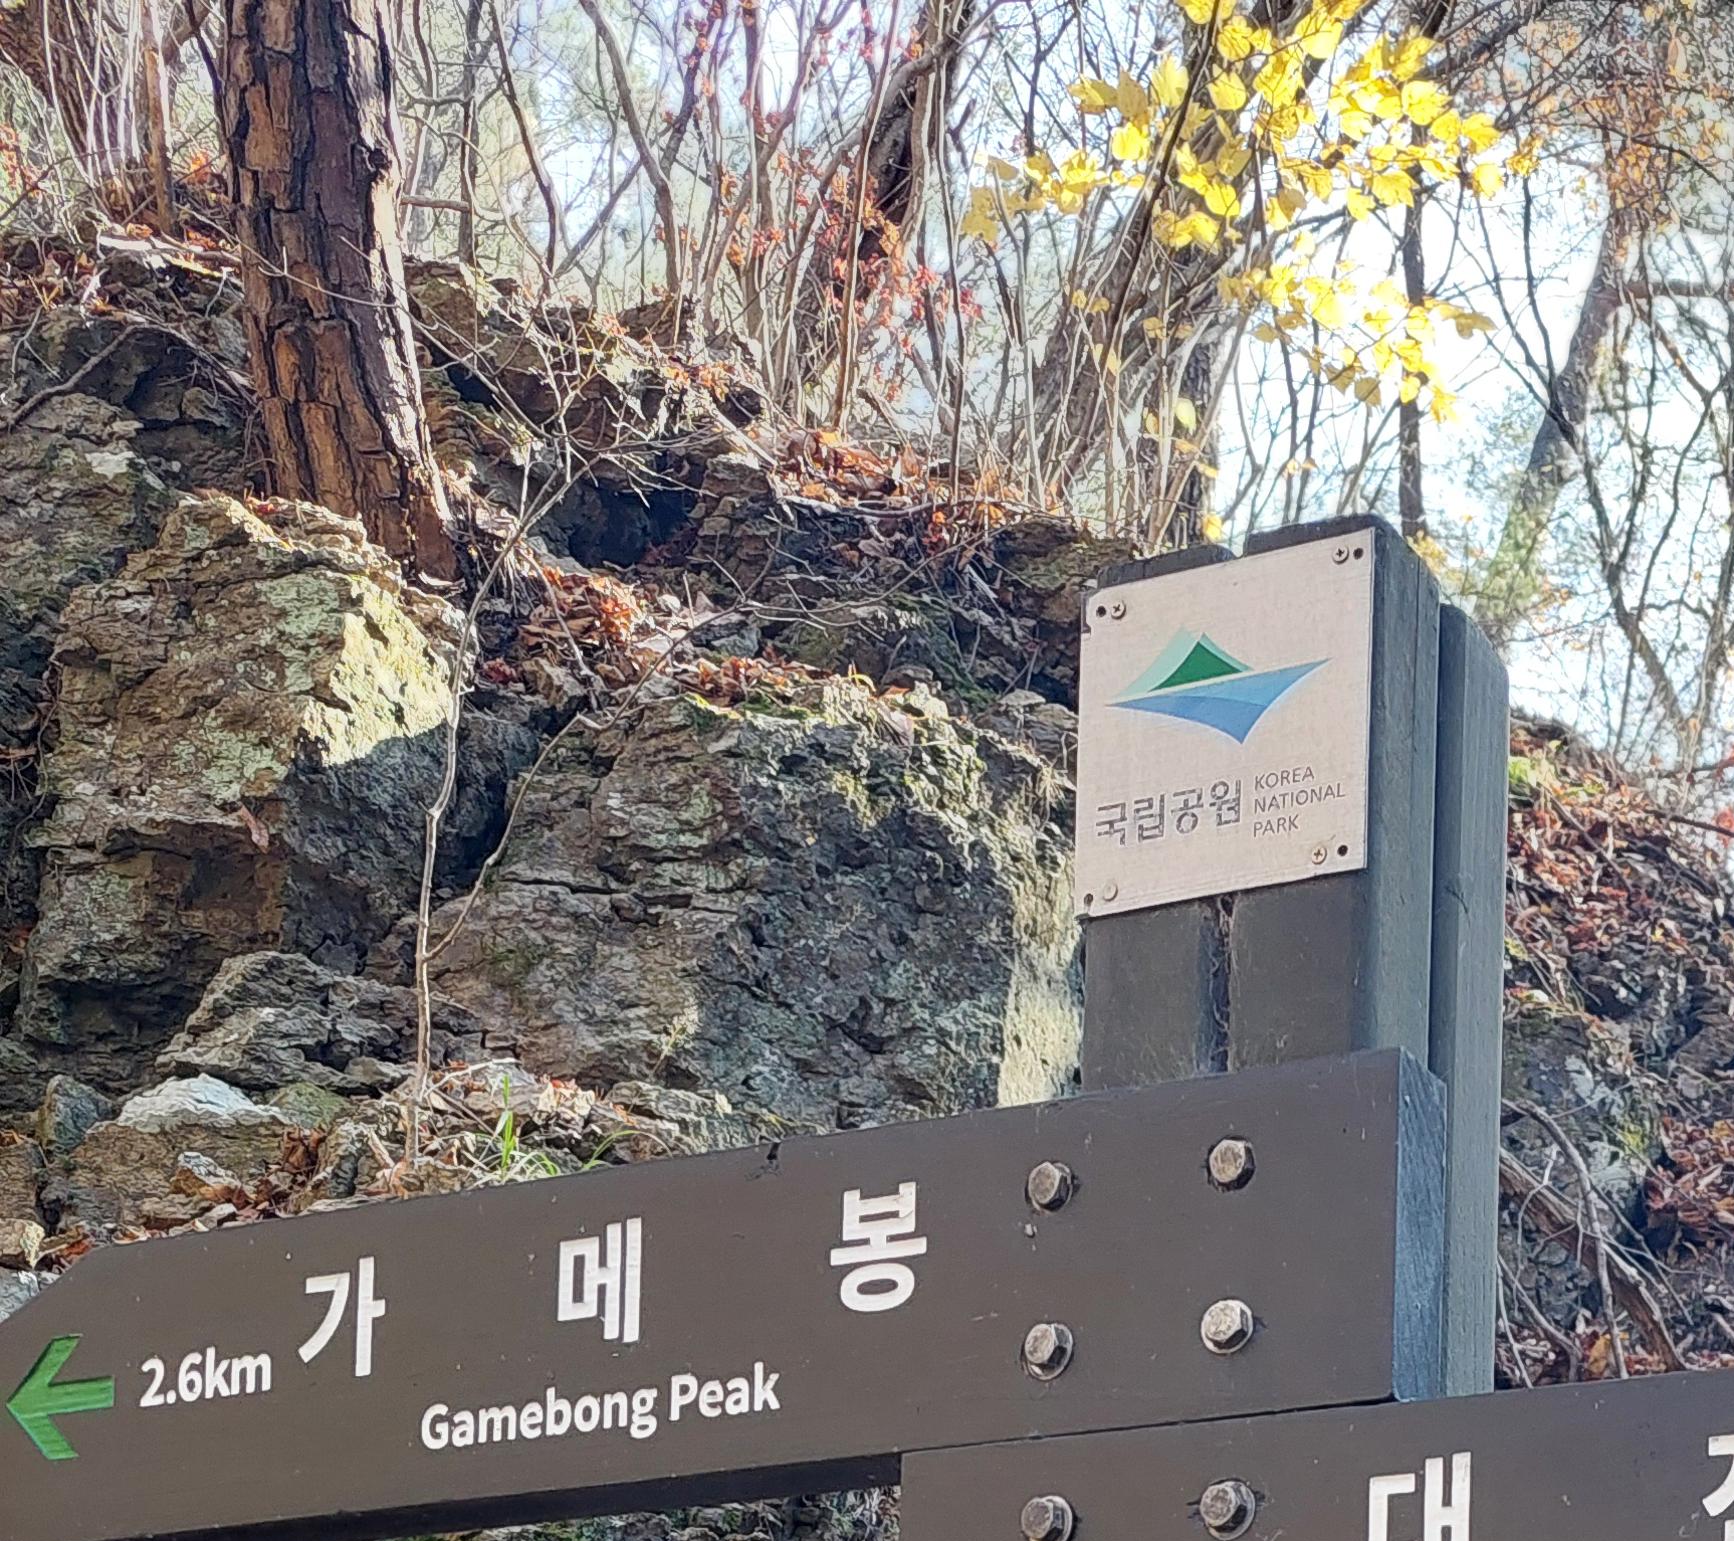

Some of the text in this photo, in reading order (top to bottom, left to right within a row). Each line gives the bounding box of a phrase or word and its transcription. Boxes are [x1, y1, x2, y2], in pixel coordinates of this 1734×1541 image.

[1254, 766, 1315, 792] KOREA
[1254, 782, 1346, 815] NATIONAL
[1095, 779, 1242, 846] 국립공원
[1253, 814, 1299, 838] PARK
[139, 1346, 272, 1408] 2.6km
[421, 1361, 781, 1450] Gamebong Peak
